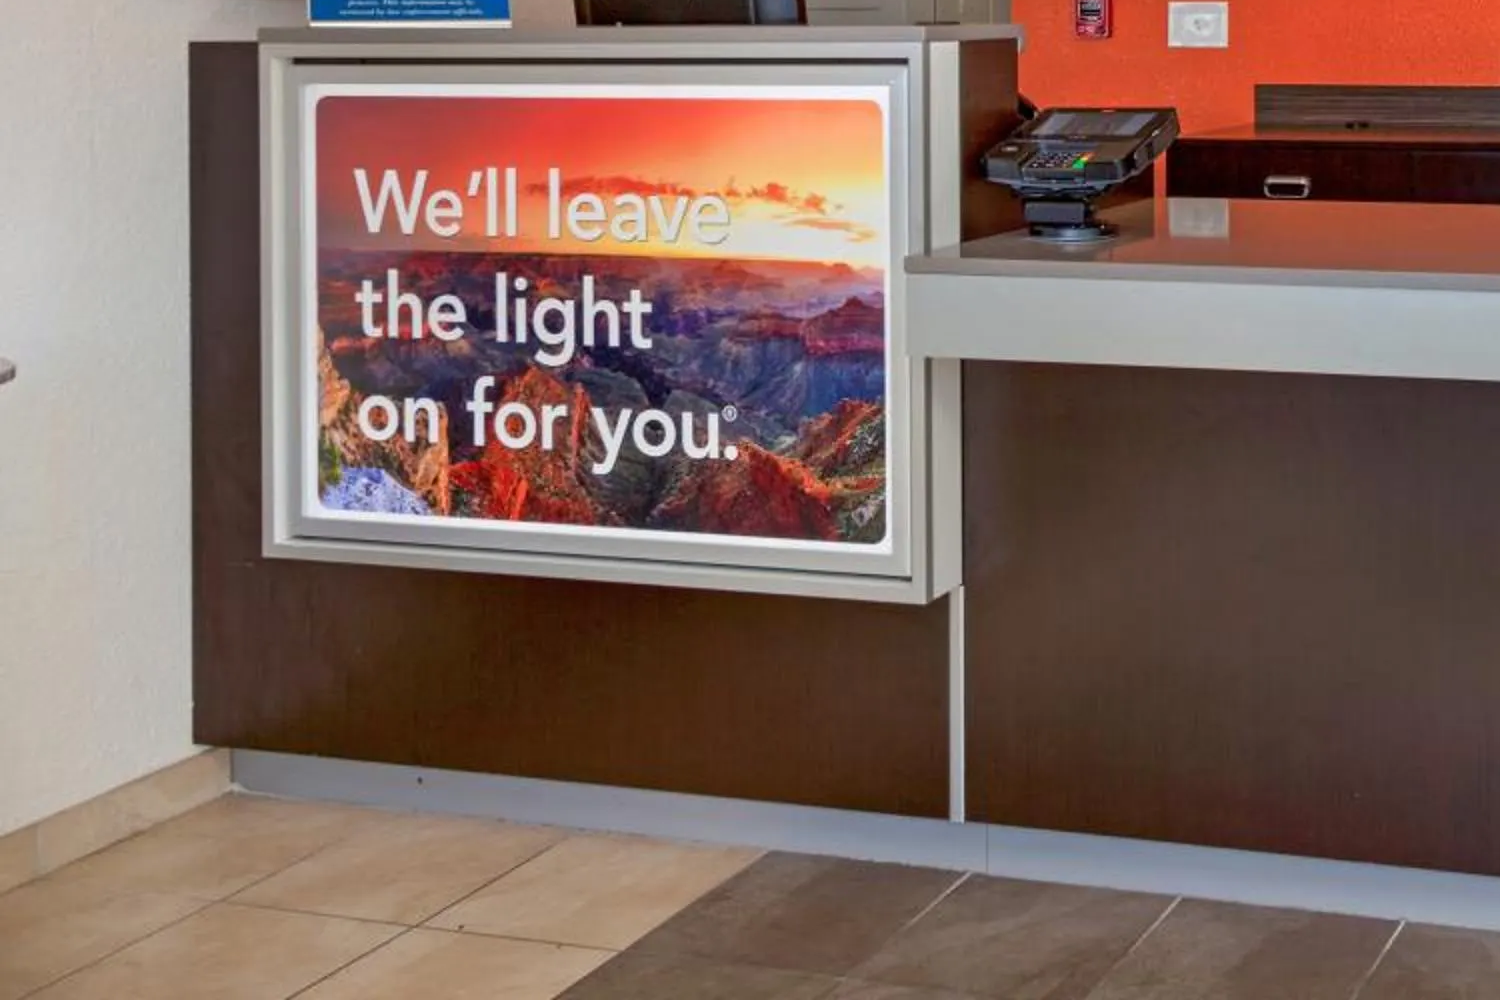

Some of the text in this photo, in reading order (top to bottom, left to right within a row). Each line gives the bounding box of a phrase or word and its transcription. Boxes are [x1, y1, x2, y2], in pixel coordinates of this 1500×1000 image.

[353, 166, 731, 245] We'll leave
[354, 268, 653, 367] the light
[356, 392, 441, 448] on
[466, 375, 569, 451] for
